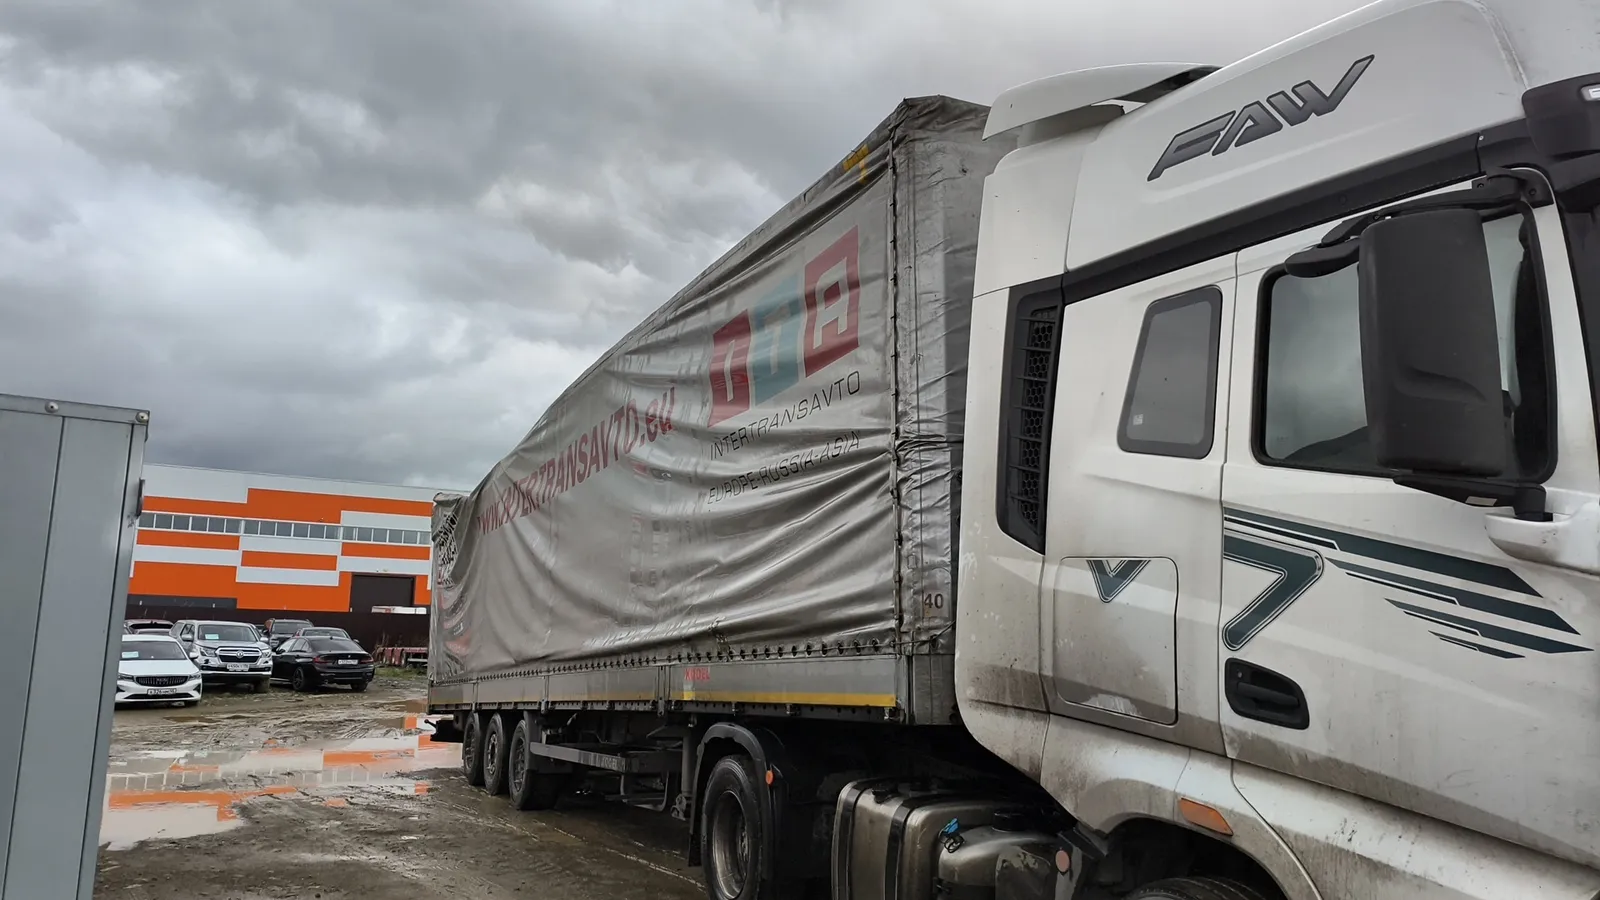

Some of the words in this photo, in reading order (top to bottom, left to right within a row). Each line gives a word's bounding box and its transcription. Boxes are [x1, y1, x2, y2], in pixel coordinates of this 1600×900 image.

[1147, 54, 1375, 182] FAW
[711, 371, 860, 460] INTERTRANSAVTO
[707, 430, 860, 504] EUROPE-RUSSIA-ASIA
[924, 593, 943, 609] 40
